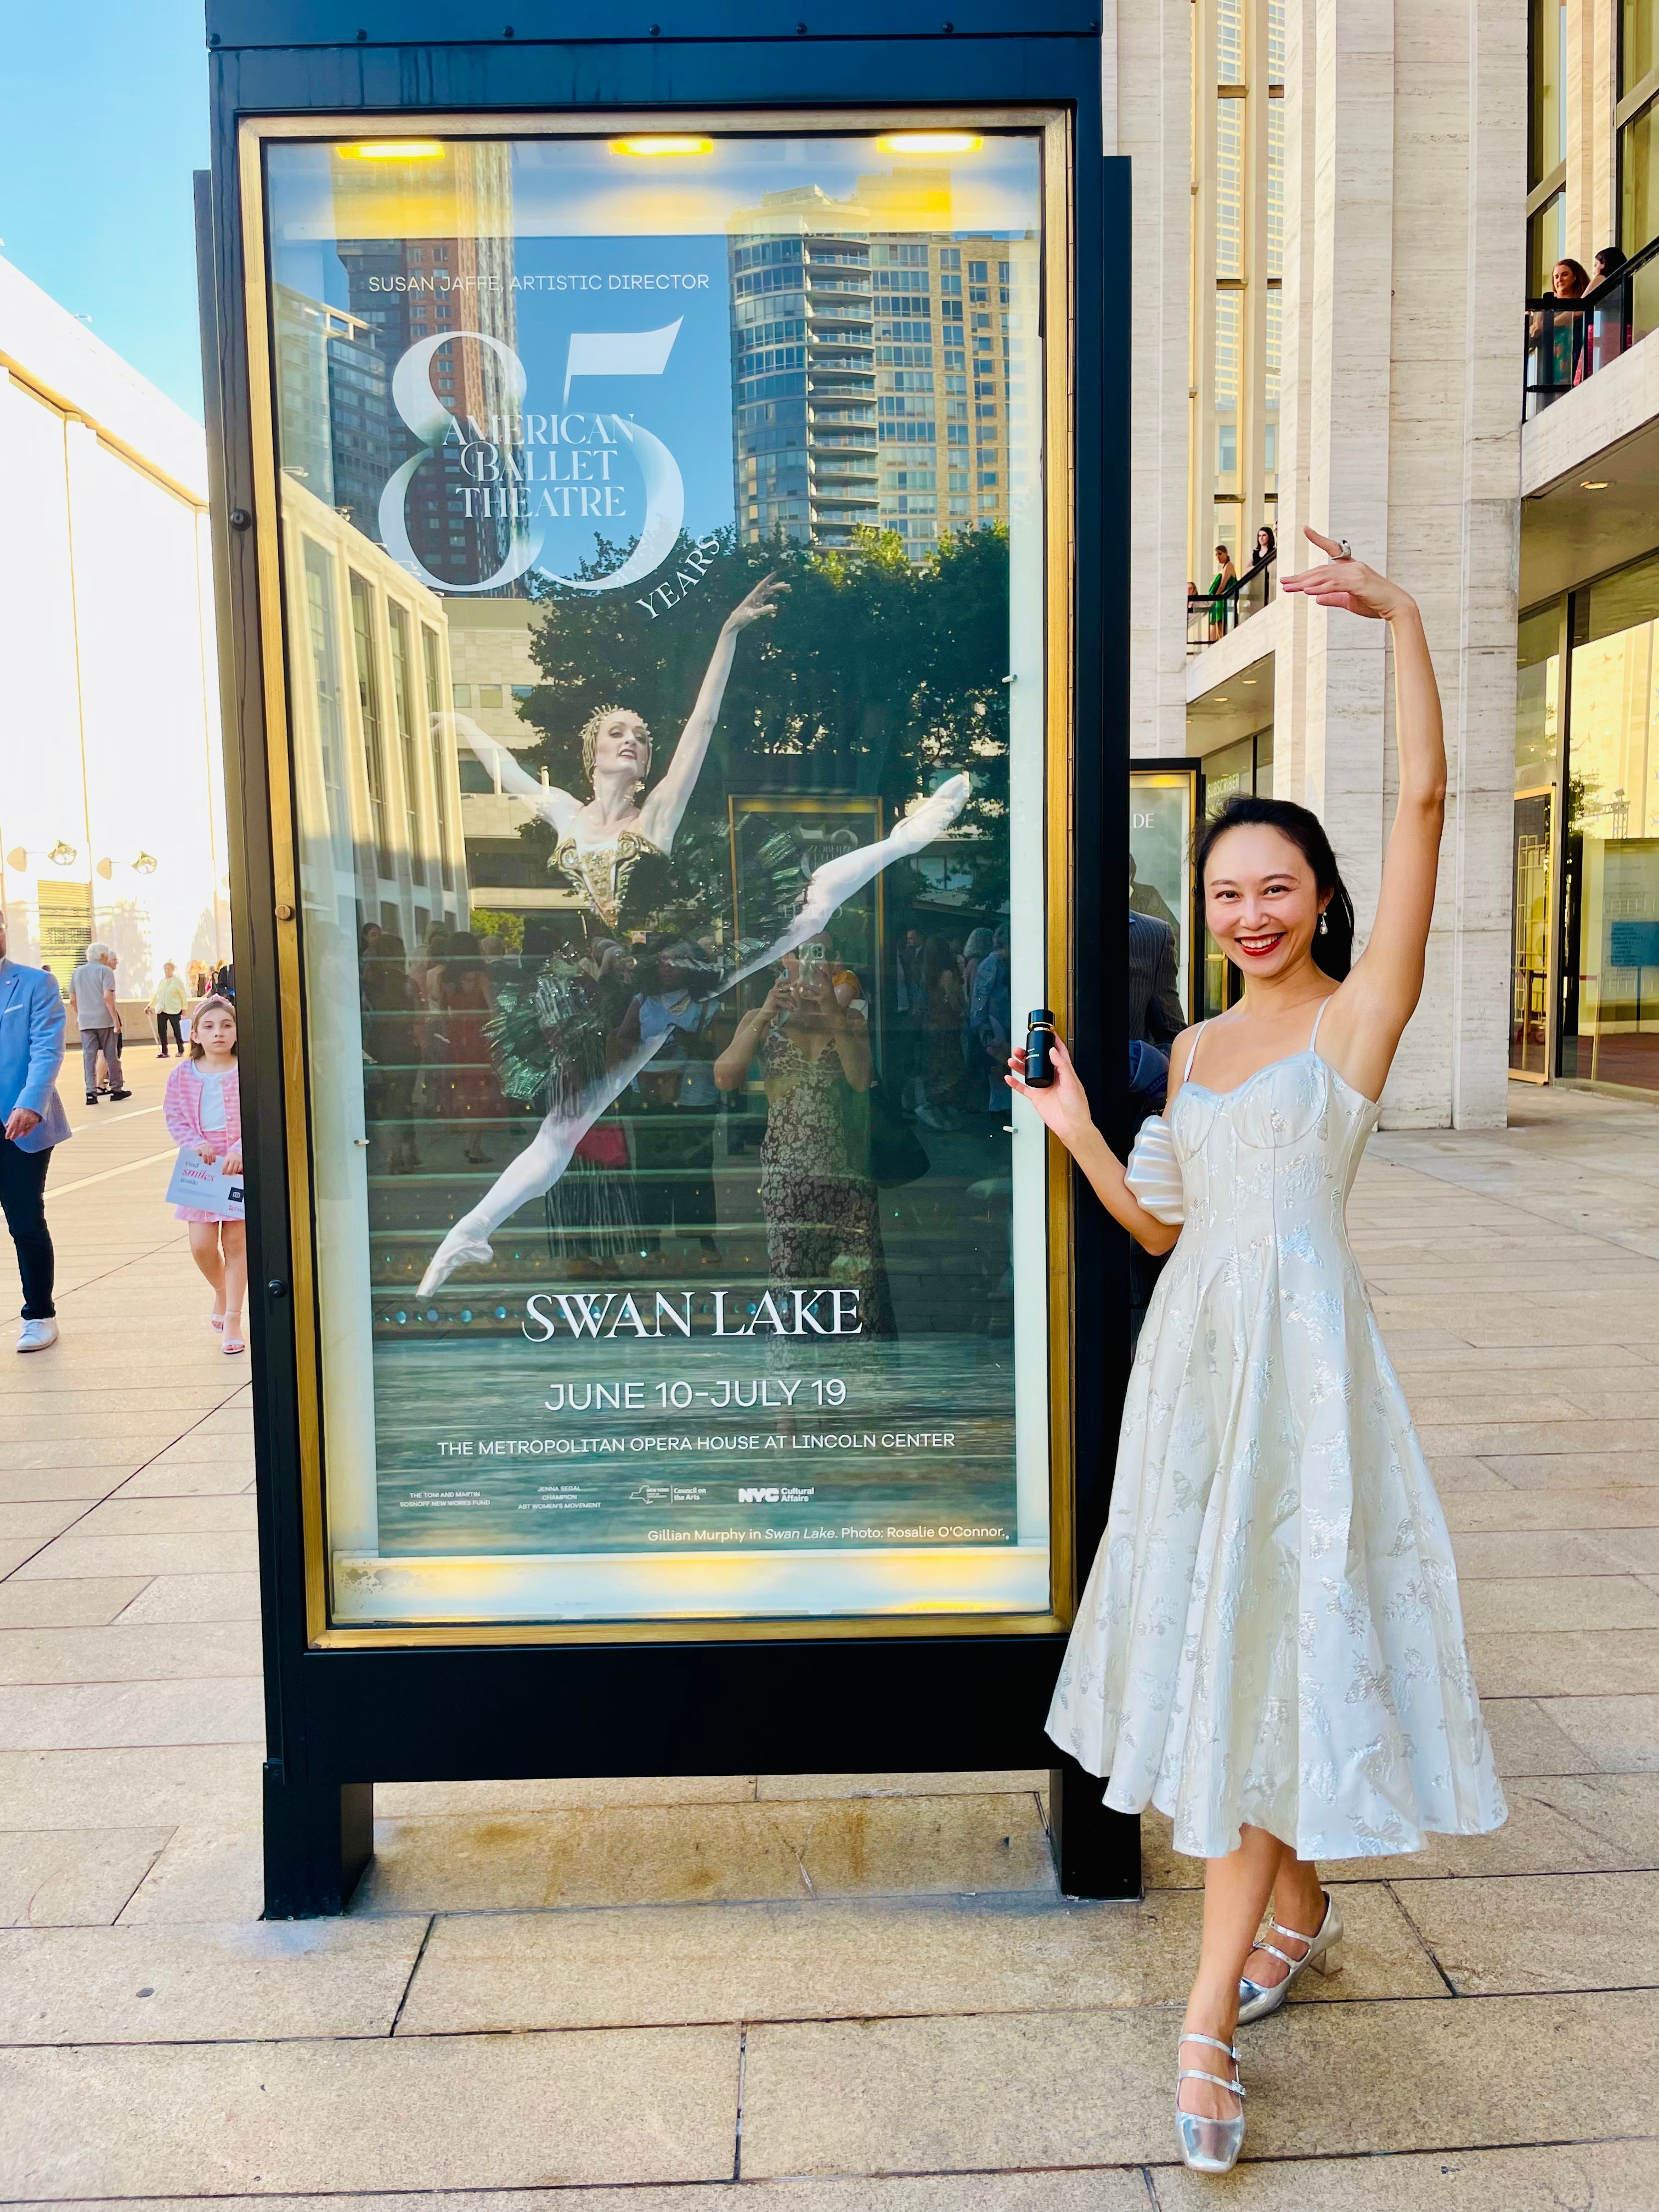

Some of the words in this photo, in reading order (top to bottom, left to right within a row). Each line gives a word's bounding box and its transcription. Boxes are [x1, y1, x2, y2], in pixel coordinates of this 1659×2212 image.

[369, 276, 435, 292] SUSAN
[440, 275, 504, 292] JAFFE,
[509, 275, 602, 291] ARTISTIC
[608, 274, 709, 290] DIRECTOR
[442, 413, 635, 445] AMERICAN
[379, 315, 684, 591] 85
[461, 441, 618, 482] BALLET
[455, 486, 627, 518] THEATRE
[635, 535, 720, 619] YEARS
[1207, 773, 1240, 798] SUBSCRIBER
[1130, 813, 1154, 828] DE
[182, 1169, 215, 1181] smiles
[522, 1291, 695, 1342] SWAN
[710, 1289, 863, 1336] LAKE
[544, 1383, 645, 1410] JUNE
[812, 1378, 847, 1406] 19
[437, 1442, 473, 1455] THE
[479, 1438, 625, 1454] METROPOLITAN
[630, 1437, 692, 1451] OPERA
[697, 1436, 760, 1450] HOUSE
[765, 1435, 787, 1449] AT
[792, 1434, 876, 1448] LINCOLN
[881, 1433, 955, 1448] CENTER
[738, 1487, 780, 1503] NYC
[648, 1529, 691, 1542] Gillian
[694, 1528, 746, 1543] Murphy
[749, 1528, 761, 1540] in
[764, 1528, 800, 1539] Swan
[803, 1527, 838, 1539] Lake.
[841, 1527, 883, 1538] Photo:
[887, 1526, 935, 1538] Rosalie
